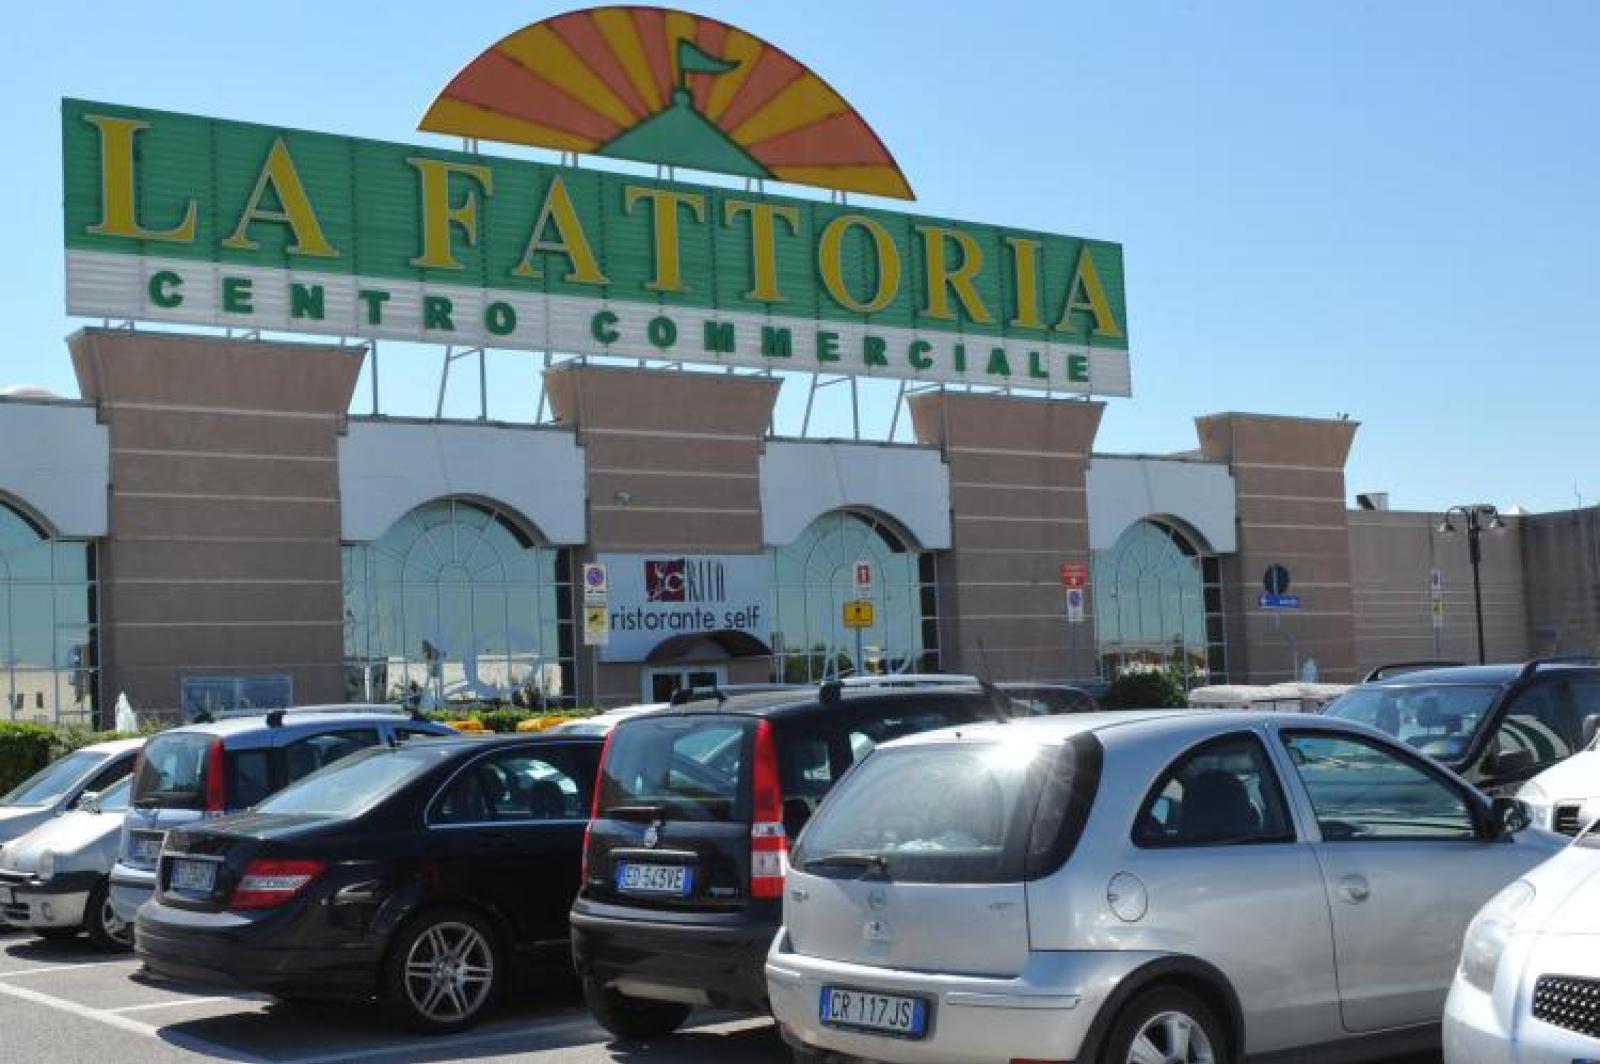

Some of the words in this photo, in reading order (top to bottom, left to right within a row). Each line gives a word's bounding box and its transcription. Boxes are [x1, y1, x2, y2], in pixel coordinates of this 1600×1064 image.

[84, 114, 338, 258] LA
[407, 157, 1122, 337] FATTORIA
[147, 271, 517, 336] CENTRO
[592, 311, 1091, 382] COMMERCIALE
[611, 605, 715, 630] ristorante
[724, 605, 760, 629] self
[831, 991, 851, 1018] CR
